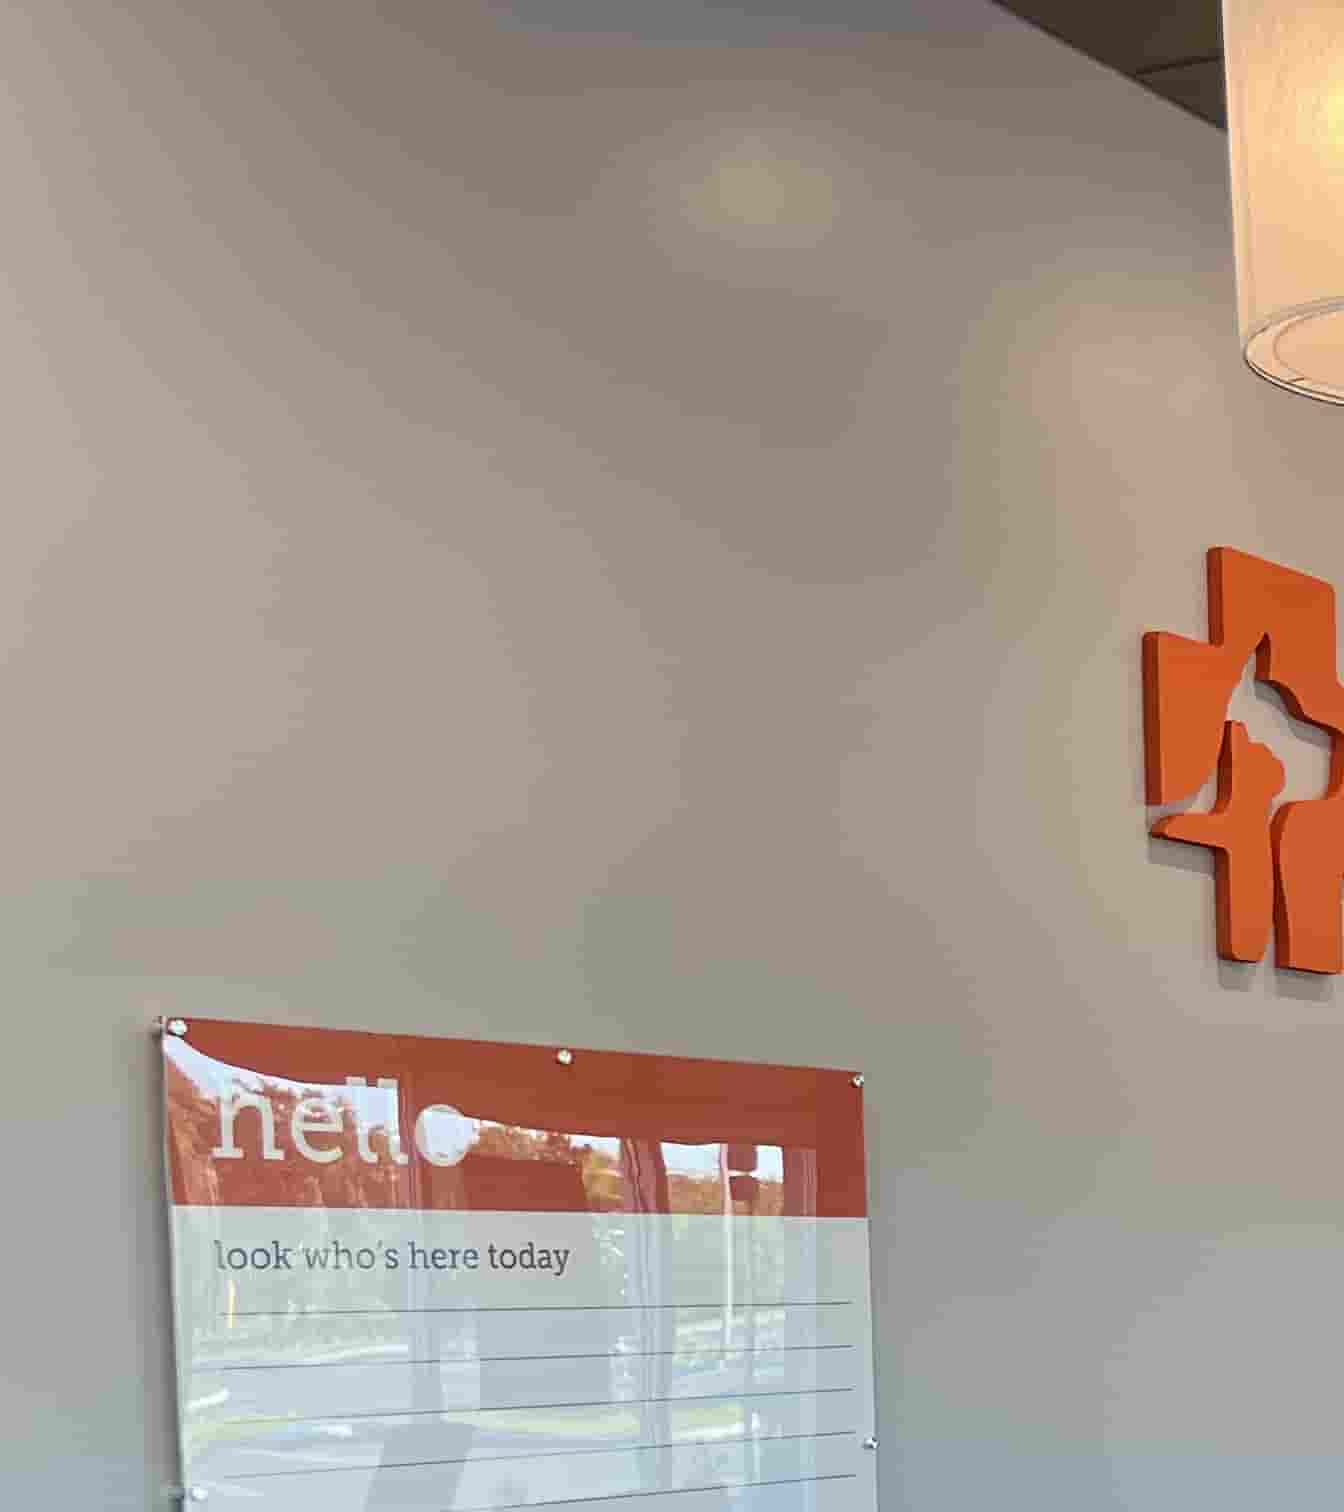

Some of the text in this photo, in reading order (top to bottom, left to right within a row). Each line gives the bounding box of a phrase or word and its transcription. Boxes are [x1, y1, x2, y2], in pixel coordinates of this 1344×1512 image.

[212, 1074, 477, 1167] hello
[214, 1240, 571, 1276] look who's here today
